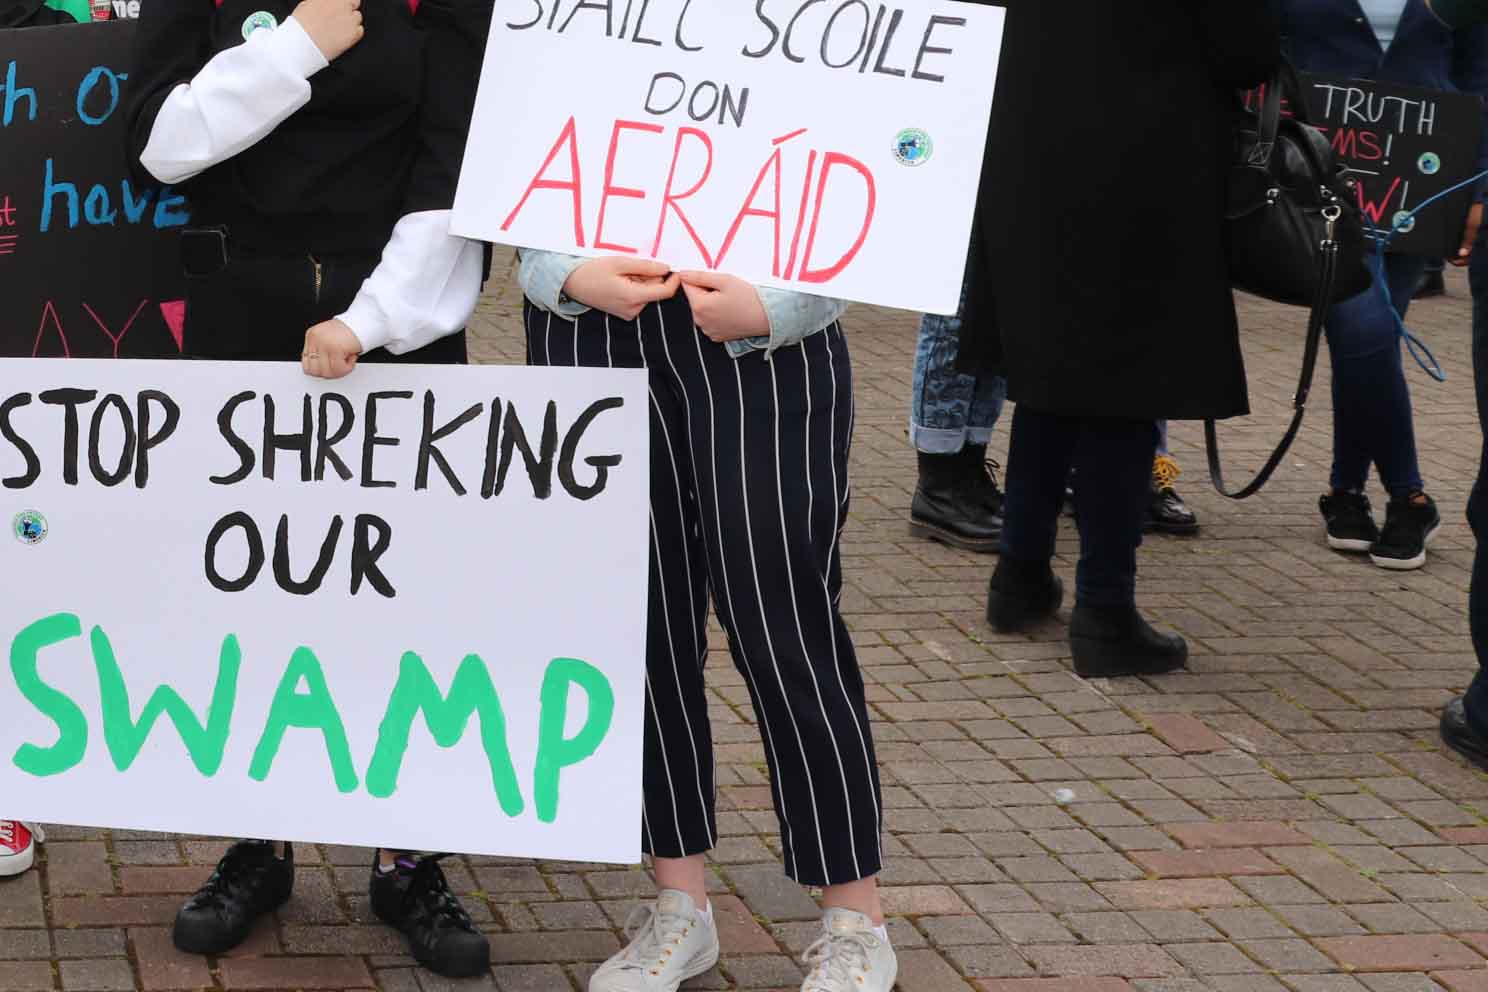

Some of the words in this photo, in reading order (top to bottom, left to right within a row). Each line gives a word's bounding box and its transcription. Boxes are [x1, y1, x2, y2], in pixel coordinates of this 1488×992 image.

[644, 71, 750, 128] DON
[1314, 84, 1436, 136] TRUTH
[500, 114, 876, 283] AERÁID
[209, 388, 625, 501] SHREKING
[204, 511, 397, 599] OUR
[9, 612, 615, 824] SWAMP
